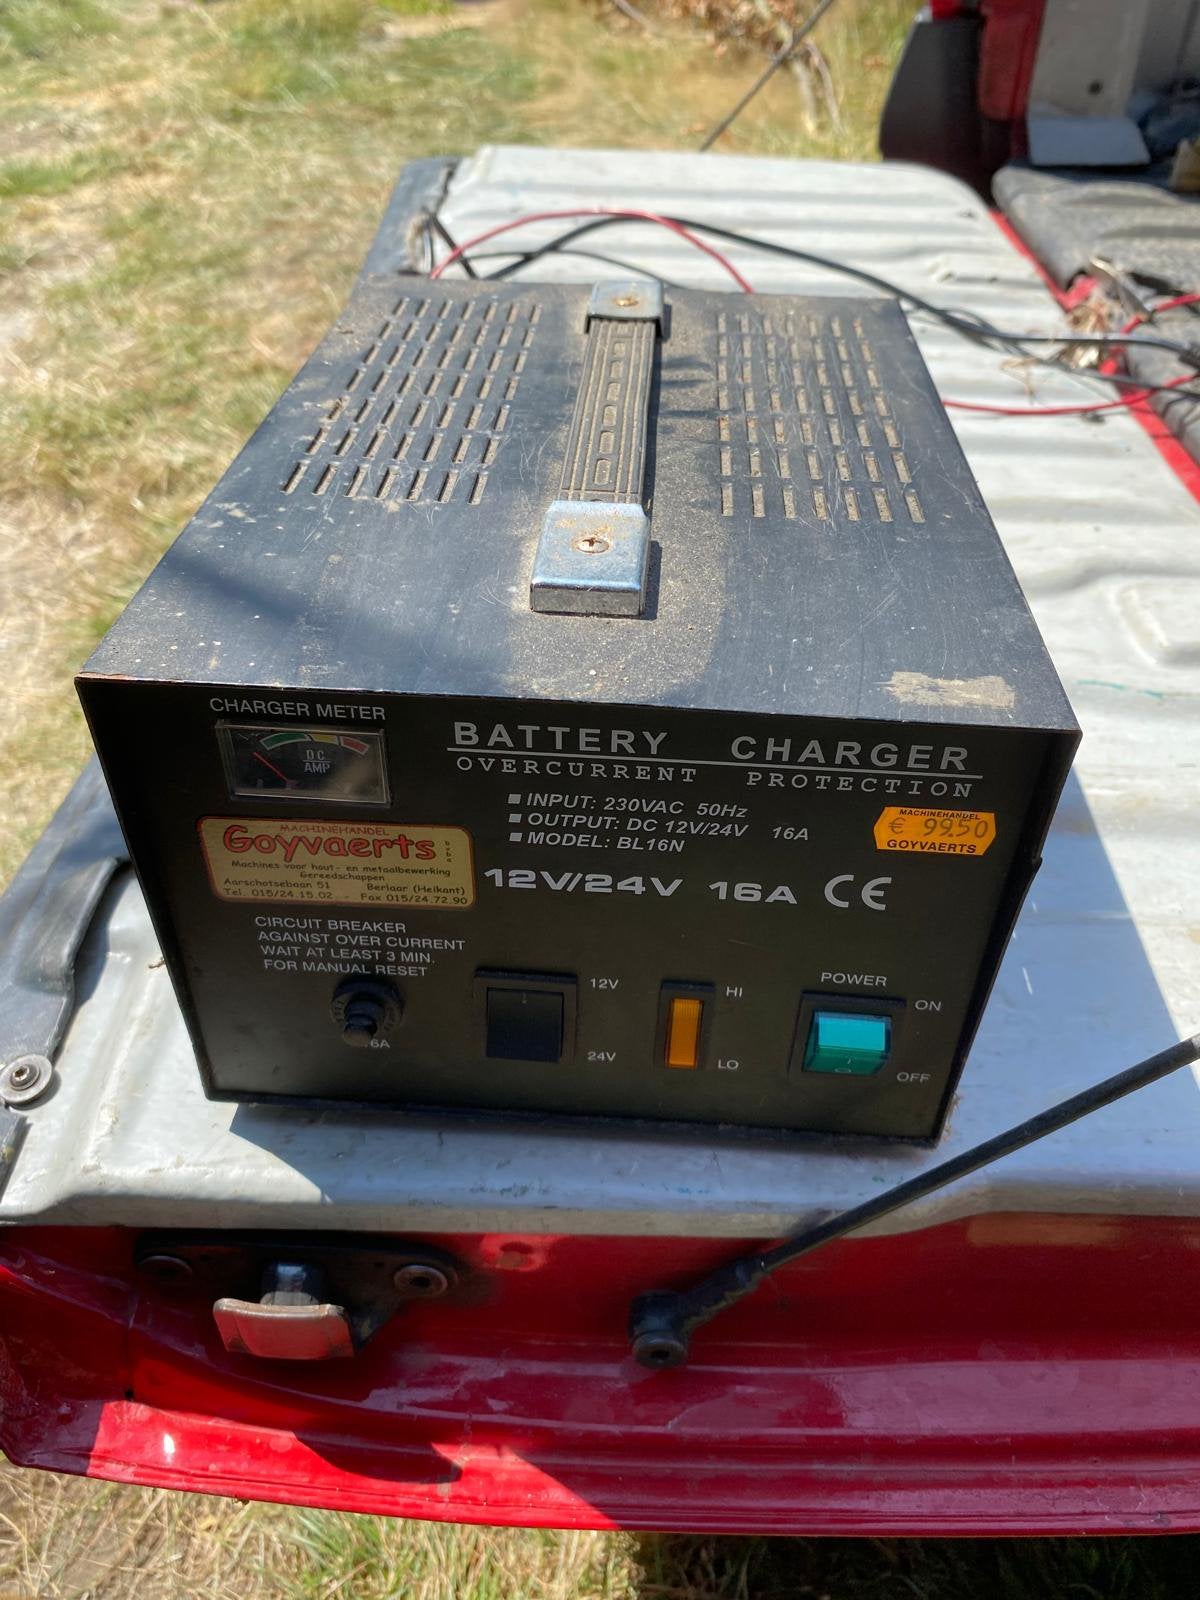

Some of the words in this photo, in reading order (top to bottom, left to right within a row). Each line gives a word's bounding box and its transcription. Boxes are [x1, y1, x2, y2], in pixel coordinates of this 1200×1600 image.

[209, 698, 310, 717] CHARGER
[316, 703, 386, 720] METER
[454, 721, 668, 755] BATTERY
[730, 735, 969, 771] CHARGER
[304, 762, 330, 774] AMP
[456, 756, 697, 782] OVERCURRENT
[746, 771, 973, 798] PROTECTION
[527, 792, 597, 810] INPUT:
[603, 797, 685, 814] 230VAC
[697, 802, 748, 818] 50Hz
[899, 808, 981, 821] MACHINEHANDEL
[280, 824, 390, 836] MACHINEHANDEL
[527, 812, 620, 831] OUTPUT:
[626, 818, 659, 832] DC
[665, 820, 749, 837] 12V/24V
[772, 826, 809, 841] 16A
[888, 818, 904, 835] €
[223, 825, 437, 862] Goyvaerts
[527, 831, 611, 848] MODEL:
[616, 836, 685, 852] BL16N
[887, 839, 977, 854] GOYVAERTS
[231, 860, 280, 870] Machines
[284, 864, 308, 872] voor
[362, 865, 451, 878] metaalbewerking
[300, 870, 386, 882] Gereedschappen
[223, 878, 313, 889] Aarschotsebaan
[317, 880, 330, 890] 51
[366, 882, 409, 893] Berlaar
[412, 884, 466, 897] (Heikant)
[484, 868, 684, 897] 12V/24V
[708, 882, 798, 905] 16A
[824, 874, 893, 911] CE
[360, 892, 382, 902] Fax
[254, 916, 323, 931] CIRCUIT
[328, 919, 407, 934] BREAKER
[258, 931, 331, 944] AGAINST
[335, 934, 382, 947] OVER
[385, 936, 466, 950] CURRENT
[260, 944, 302, 957] WAIT
[306, 946, 325, 958] AT
[330, 948, 381, 961] LEAST
[386, 951, 396, 962] 3
[400, 951, 436, 964] MIN.
[264, 958, 299, 971] FOR
[302, 960, 371, 975] MANUAL
[375, 963, 428, 977] RESET
[590, 977, 620, 990] 12V
[821, 972, 888, 987] POWER
[726, 986, 743, 997] HI
[915, 1000, 942, 1012] ON
[587, 1051, 617, 1062] 24V
[718, 1059, 740, 1070] LO
[896, 1071, 931, 1084] OFF
